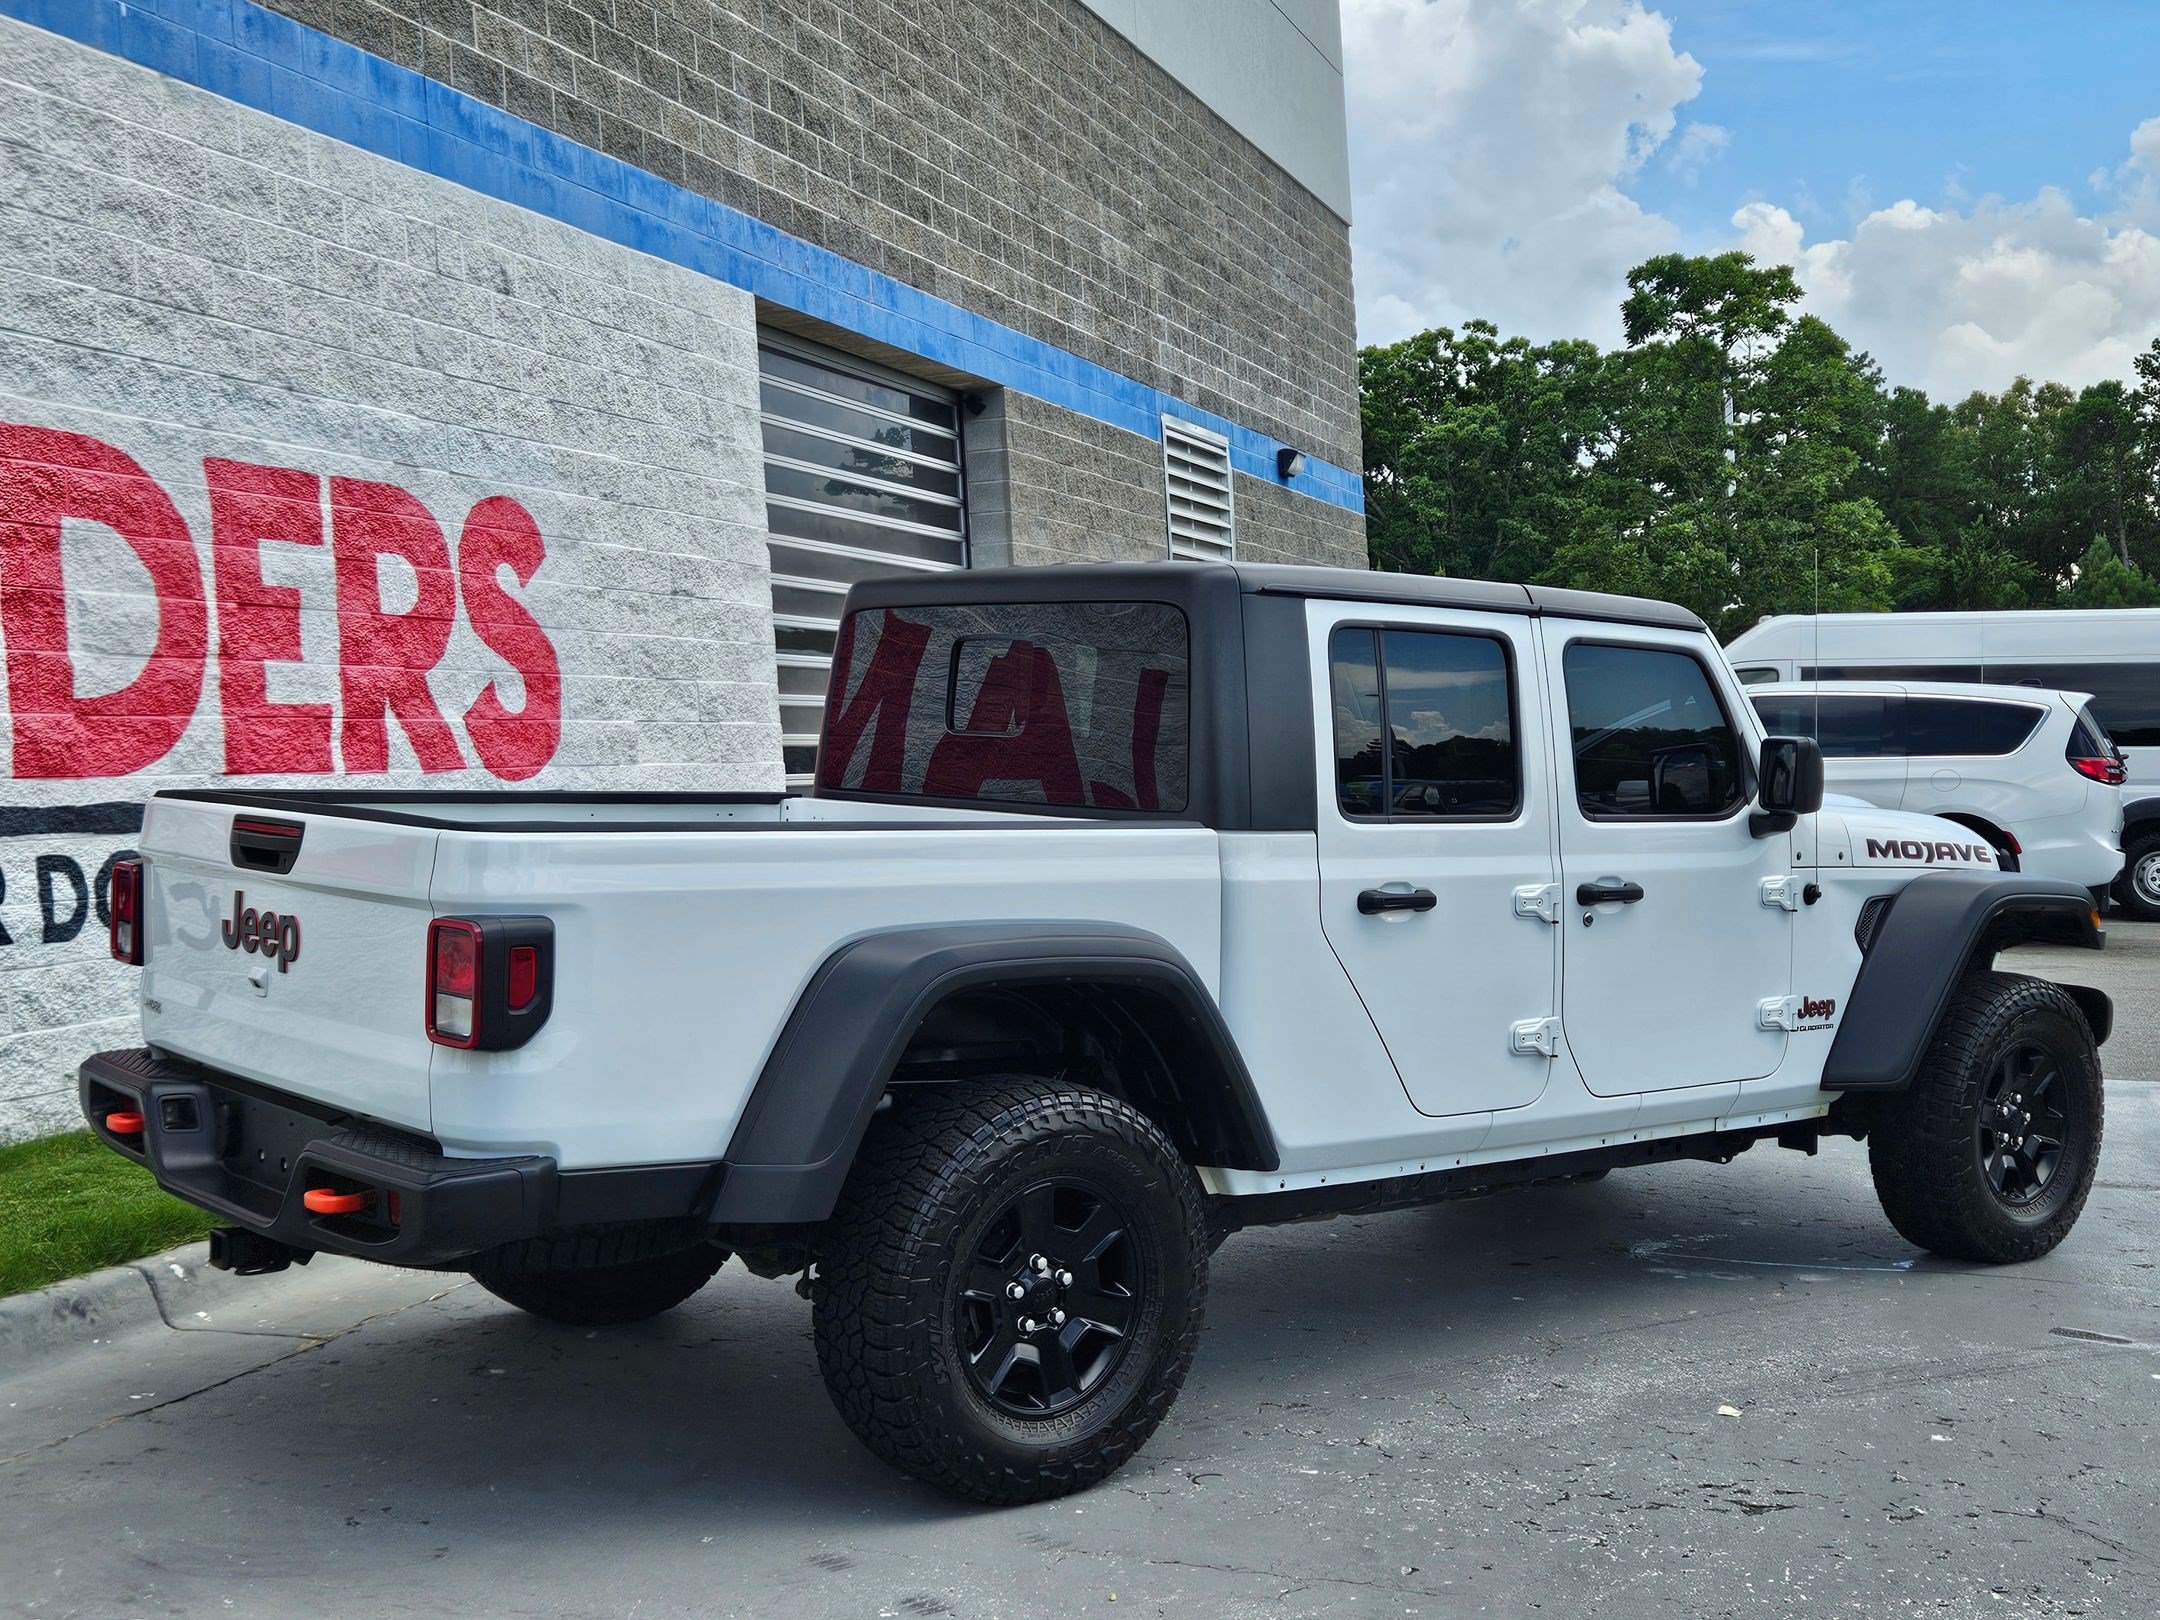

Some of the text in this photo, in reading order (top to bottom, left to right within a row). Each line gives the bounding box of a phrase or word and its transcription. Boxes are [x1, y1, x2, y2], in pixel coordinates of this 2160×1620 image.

[0, 421, 562, 782] DERS
[1866, 838, 1993, 864] MOJAVE
[222, 890, 300, 974] Jeep
[1797, 996, 1836, 1021] Jeep
